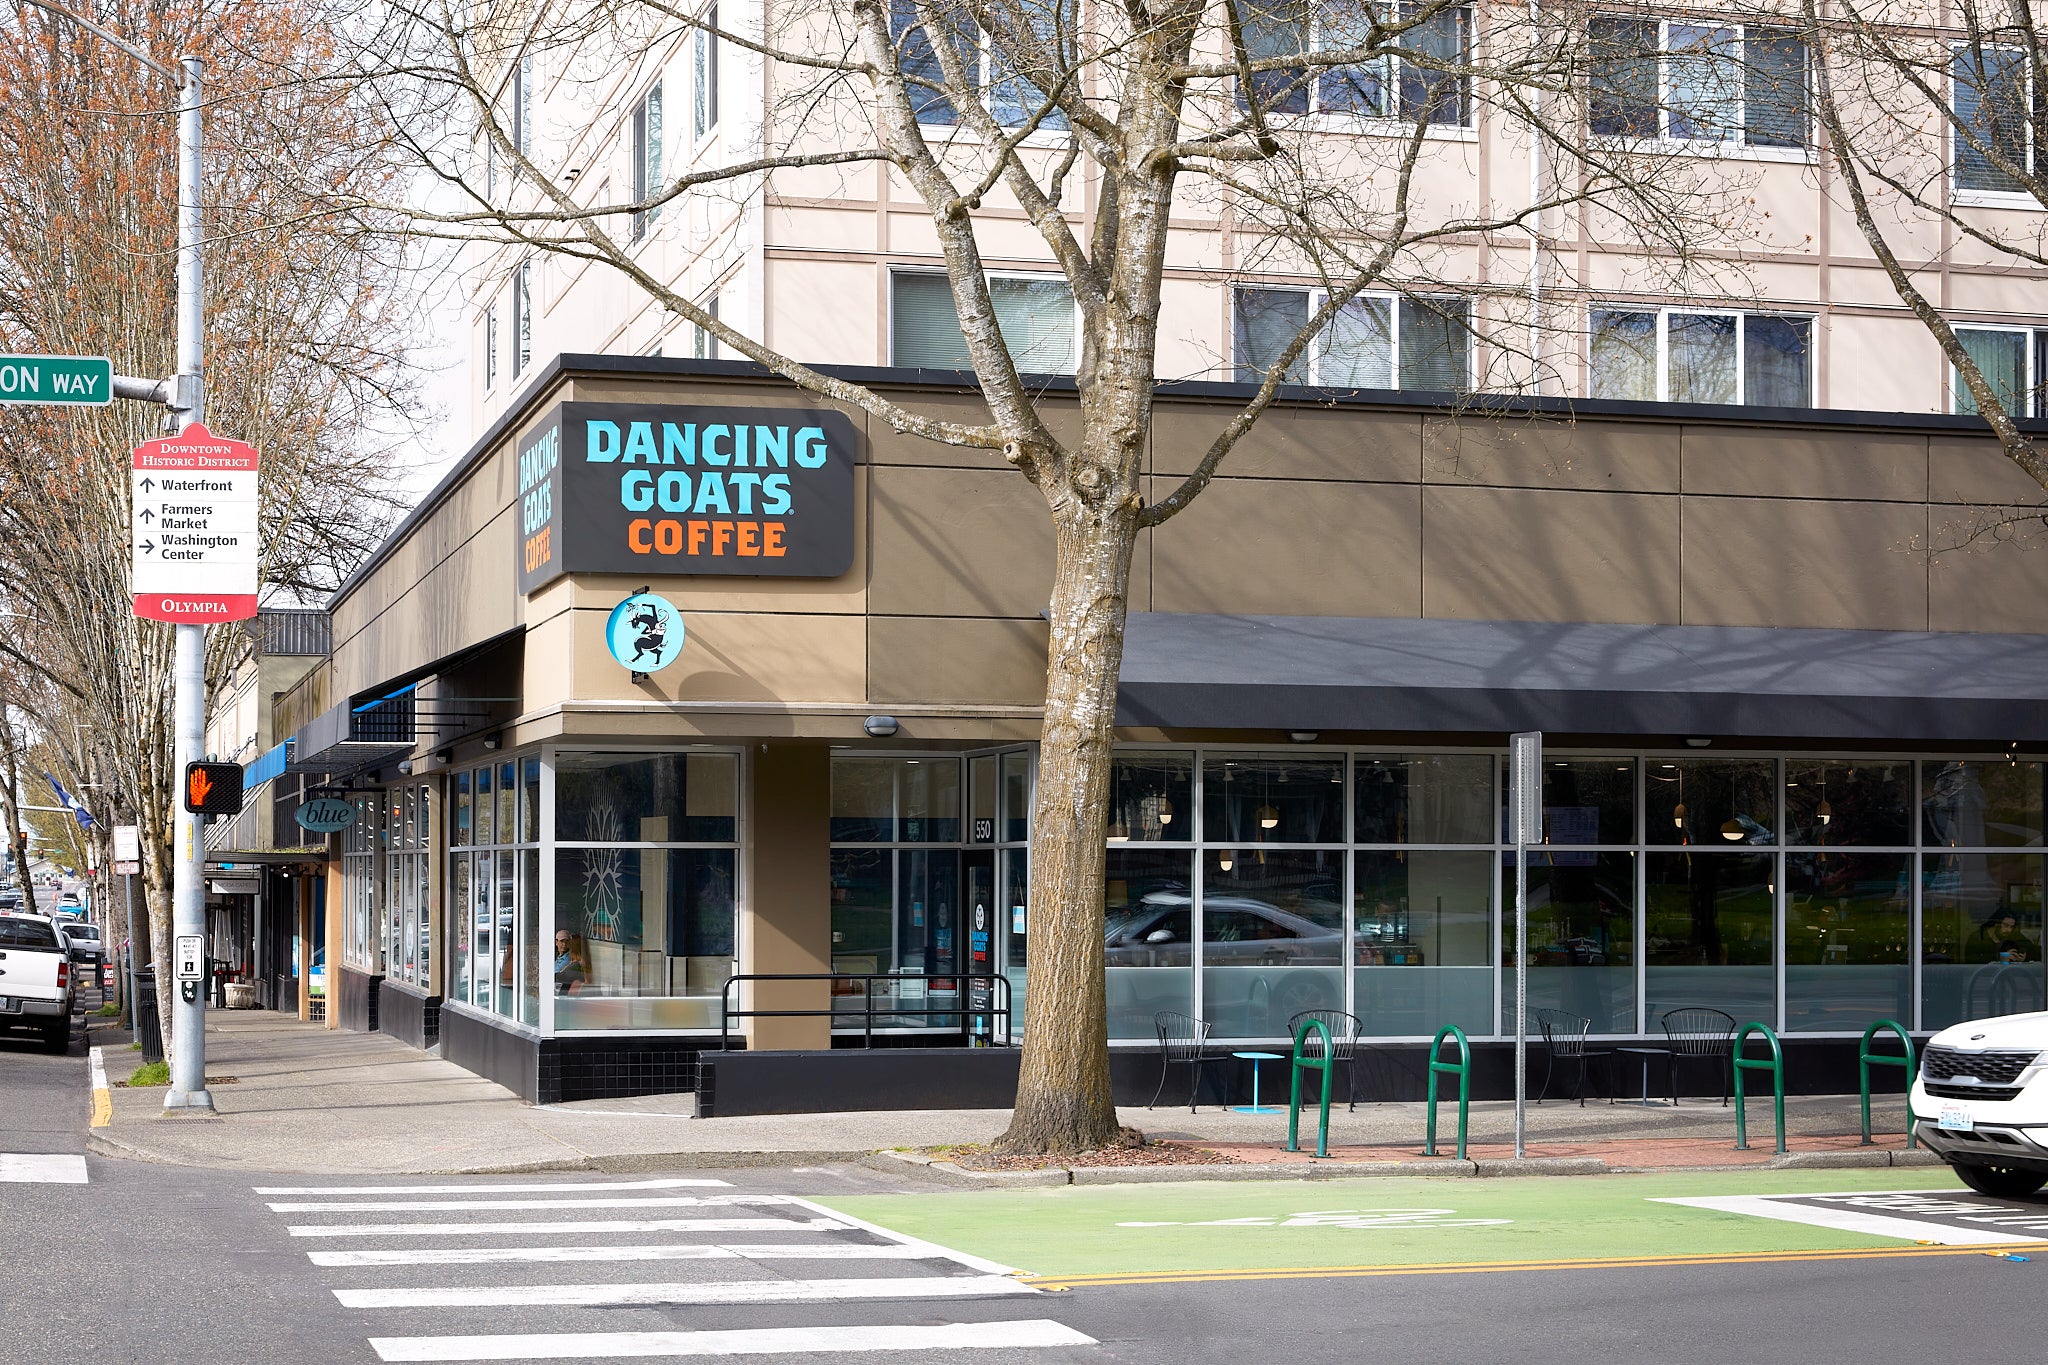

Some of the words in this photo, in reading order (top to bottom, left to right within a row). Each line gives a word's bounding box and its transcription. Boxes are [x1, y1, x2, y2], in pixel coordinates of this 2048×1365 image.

[52, 374, 99, 395] WAY
[586, 420, 828, 469] DANCING
[519, 425, 559, 496] DANCING
[161, 479, 233, 492] Waterfront
[621, 469, 792, 515] GOATS
[161, 503, 213, 515] Farmers
[524, 477, 552, 536] GOATS
[161, 518, 208, 530] Market
[161, 534, 238, 550] Washington
[628, 518, 787, 557] COFFEE
[161, 548, 205, 560] Center
[525, 526, 551, 574] COFFEE
[306, 801, 350, 824] blue
[975, 819, 991, 840] 550
